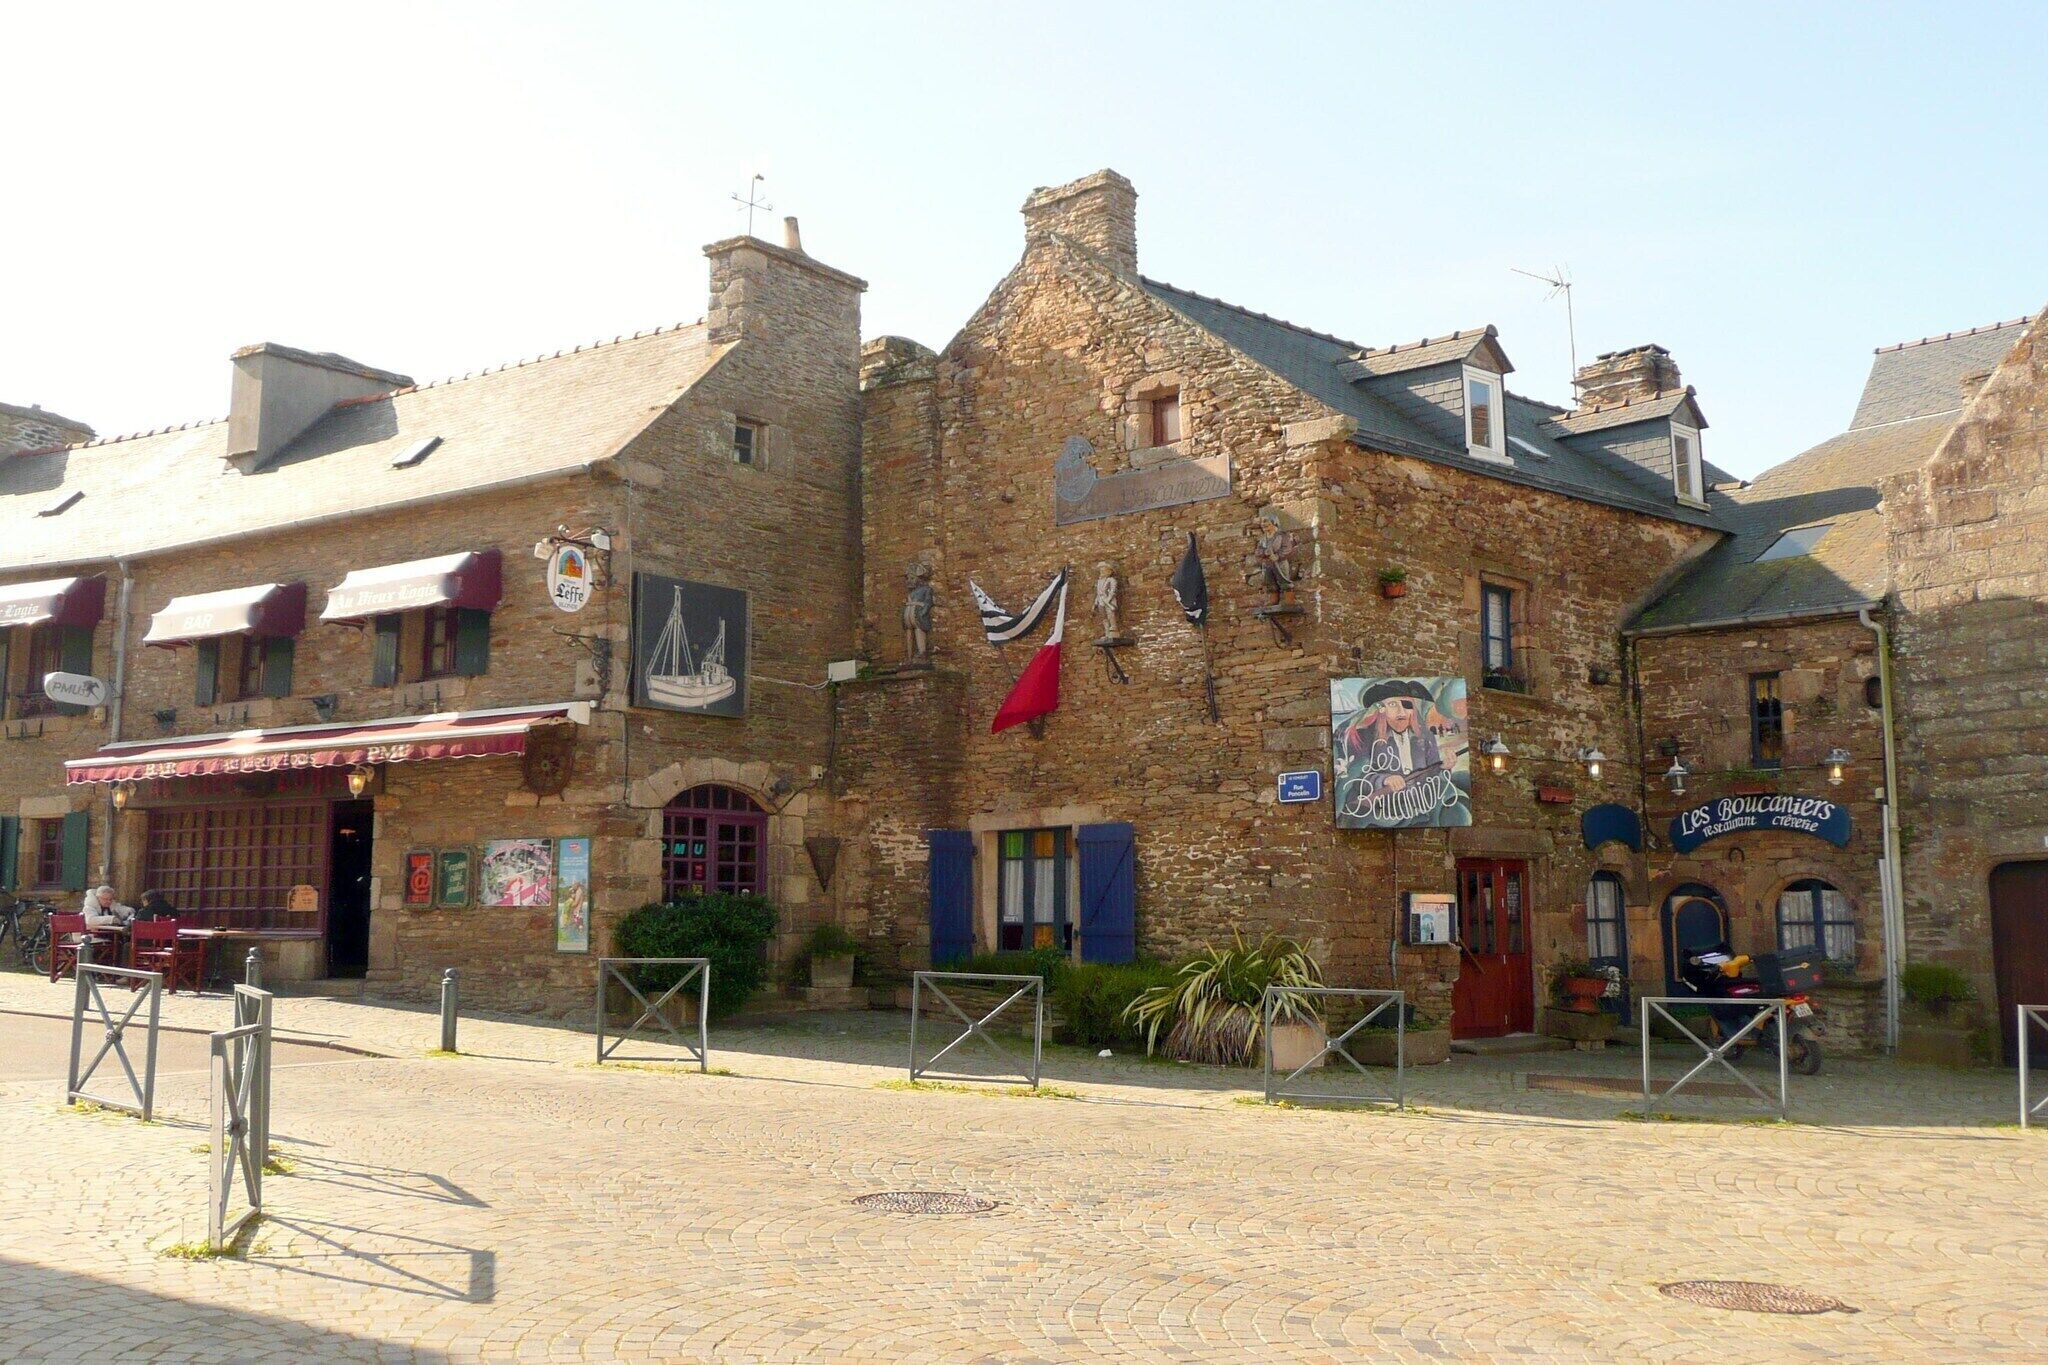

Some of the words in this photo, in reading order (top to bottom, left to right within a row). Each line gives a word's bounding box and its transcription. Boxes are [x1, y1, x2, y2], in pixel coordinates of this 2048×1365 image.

[398, 583, 439, 600] Logis
[555, 582, 584, 603] Leffe
[183, 613, 215, 628] BAR
[52, 682, 81, 695] PMU
[145, 761, 177, 777] BAR
[367, 745, 411, 762] PMU
[1361, 738, 1402, 773] Les
[1681, 805, 1711, 836] Les
[1717, 795, 1836, 821] Boucaniers
[1702, 815, 1758, 838] restaurant
[1771, 814, 1819, 832] crêperie
